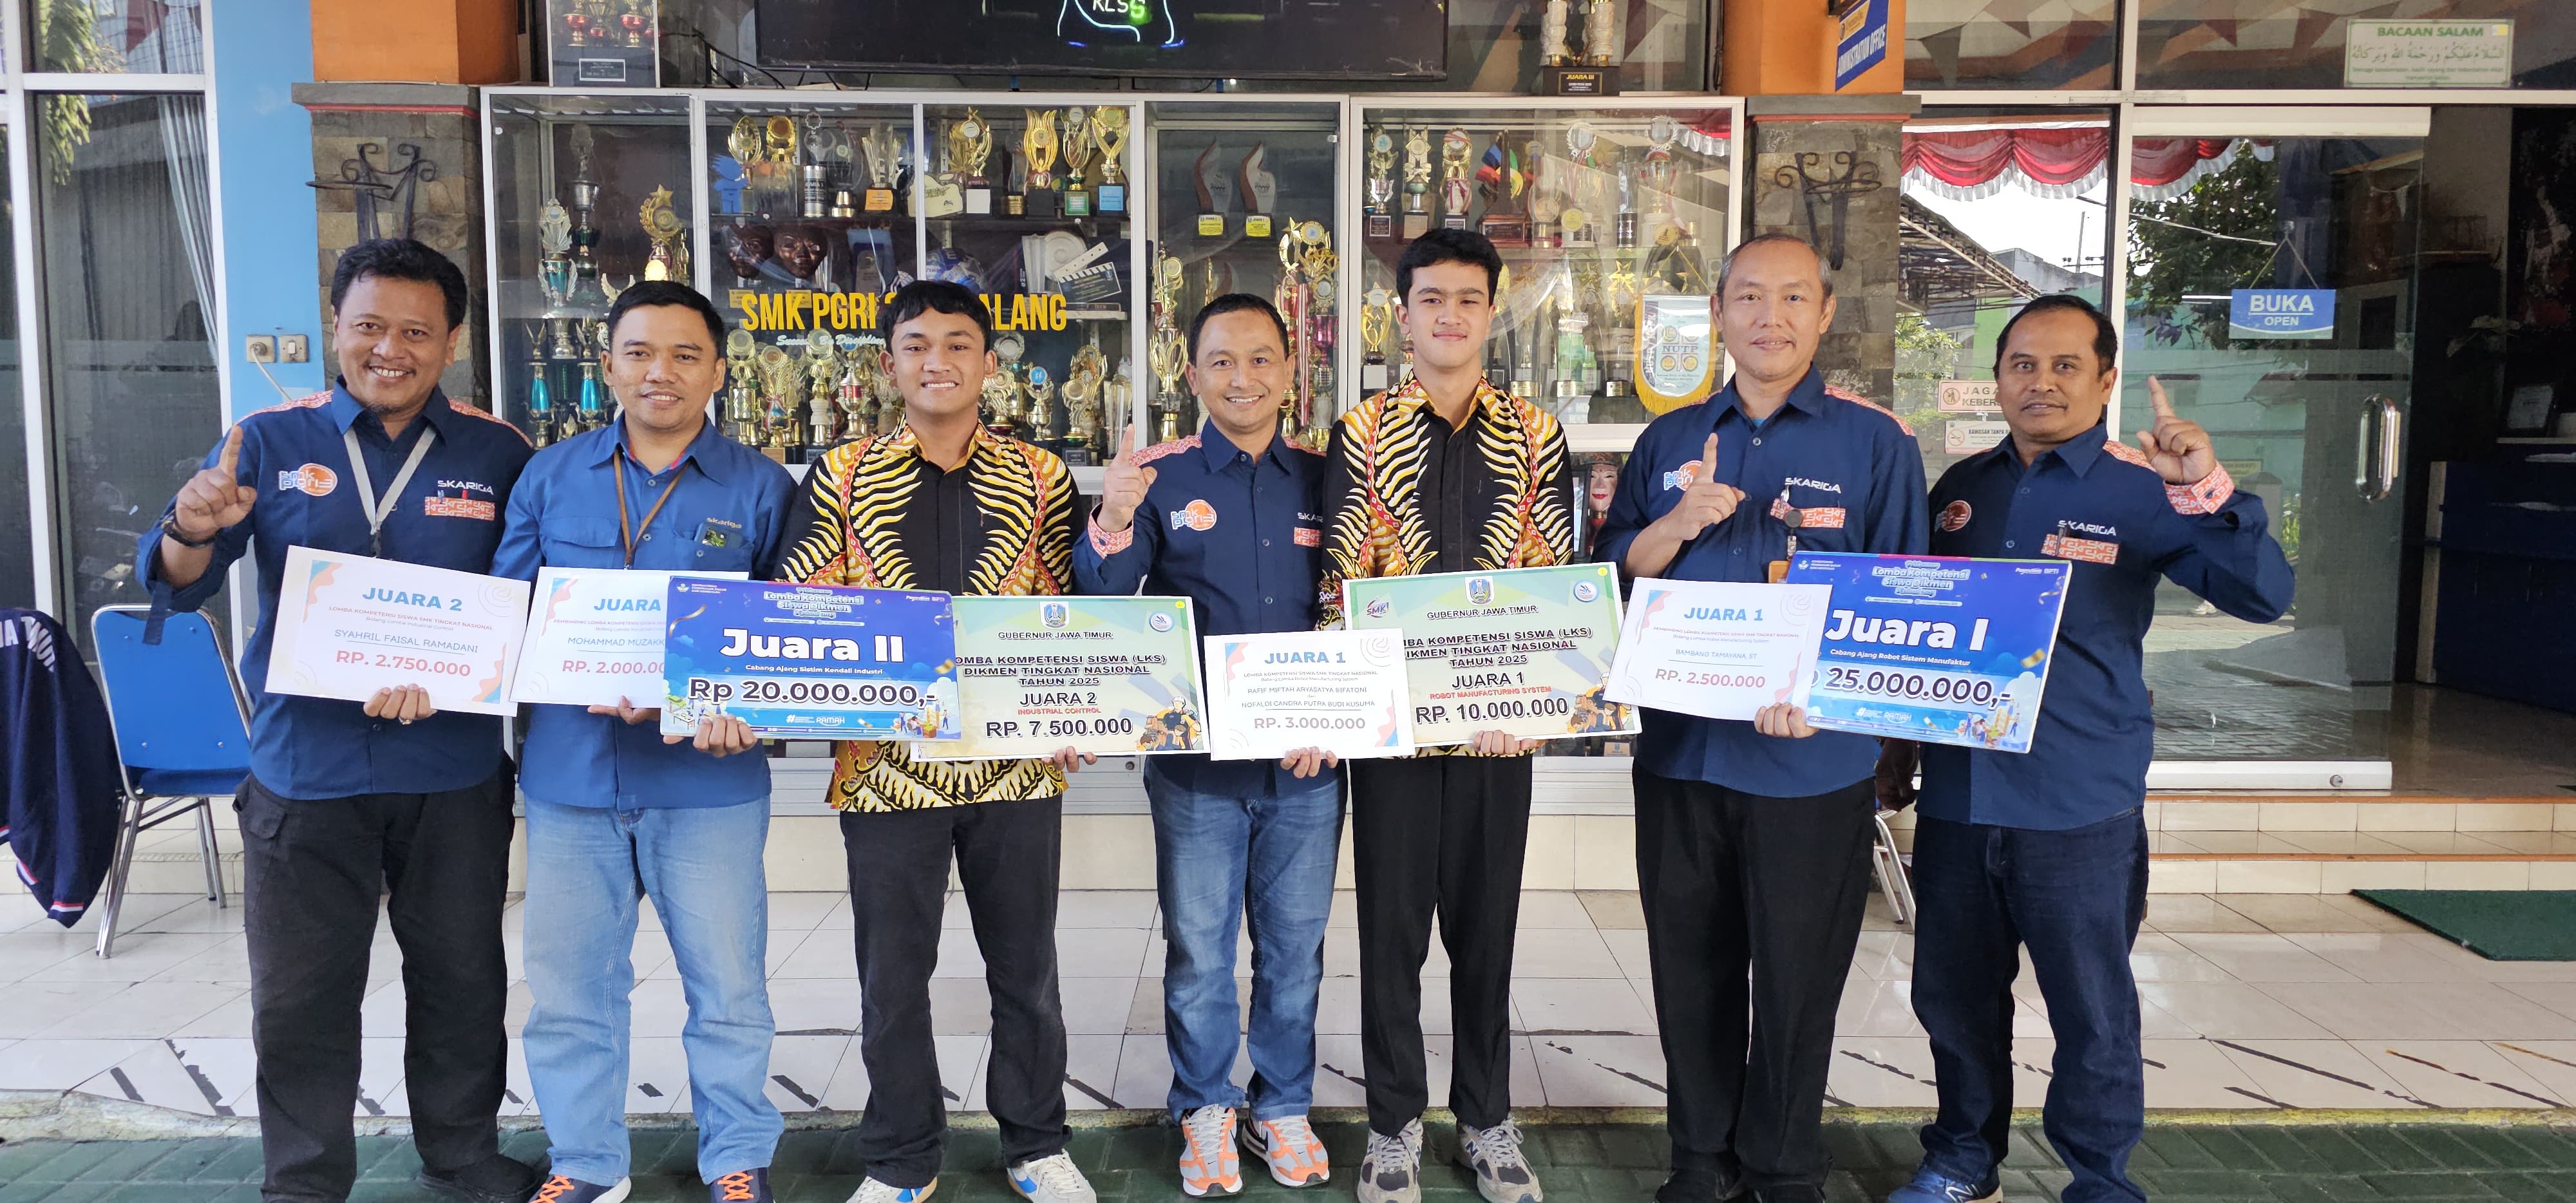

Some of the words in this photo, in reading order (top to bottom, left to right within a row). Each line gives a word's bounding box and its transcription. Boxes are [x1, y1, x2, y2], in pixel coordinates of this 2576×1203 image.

[2377, 27, 2432, 37] BACAAN
[2437, 27, 2484, 37] SALAM
[1870, 24, 1886, 55] OFFICE
[2249, 294, 2314, 312] BUKA
[742, 293, 806, 330] SMK
[813, 292, 876, 330] PGRI
[979, 293, 1066, 330] LANG
[2264, 316, 2299, 326] OPEN
[1963, 386, 2000, 395] JAGA
[437, 479, 495, 495] SKARIGA
[1785, 477, 1842, 494] SKARIGA
[1297, 512, 1324, 523] SKAR
[2058, 520, 2117, 536] SKARIGA
[1872, 566, 1907, 576] Lomba
[1908, 568, 1971, 580] Kompetensi
[1882, 576, 1911, 587] Siswa
[1912, 578, 1953, 590] Dikmen
[362, 587, 442, 609] JUARA
[450, 598, 462, 612] 2
[594, 598, 661, 611] JUARA
[764, 591, 801, 602] Lomba
[802, 592, 864, 605] Kompetensi
[777, 601, 809, 611] Siswa
[810, 602, 851, 612] Dikmen
[1427, 609, 1479, 620] GUBERNUR
[1481, 607, 1506, 616] JAWA
[1508, 605, 1539, 614] TIMUR
[354, 609, 396, 618] KOMPETENSI
[397, 613, 418, 621] SISWA
[434, 618, 461, 627] TINGKAT
[462, 622, 493, 630] NASIONAL
[1683, 607, 1747, 621] JUARA
[1754, 609, 1763, 621] 1
[998, 631, 1053, 639] GUBERNUR
[1055, 631, 1081, 639] JAWA
[1083, 631, 1113, 639] TIMUR
[1428, 633, 1511, 645] KOMPETENSI
[1514, 630, 1555, 640] SISWA
[1558, 627, 1593, 638] (LKS)
[1824, 609, 1956, 649] Juara
[1969, 618, 1989, 651] I
[334, 629, 381, 641] SYAHRIL
[384, 634, 421, 646] FAISAL
[423, 639, 478, 653] RAMADANI
[567, 637, 625, 647] MOHAMMAD
[627, 638, 665, 647] MUZAKK
[719, 628, 860, 662] Juara
[874, 634, 904, 663] II
[1406, 649, 1447, 658] IKMEN
[1451, 645, 1508, 656] TINGKAT
[1511, 639, 1577, 651] NASIONAL
[1676, 649, 1710, 658] BAMBANG
[336, 650, 369, 665] RP.
[375, 654, 471, 677] 2.750.000
[956, 656, 992, 665] OMBA
[998, 656, 1083, 665] KOMPETENSI
[1088, 655, 1128, 664] SISWA
[1132, 654, 1166, 664] (LKS)
[1264, 652, 1329, 664] JUARA
[1336, 652, 1346, 663] 1
[1449, 658, 1493, 668] TAHUN
[1498, 655, 1528, 665] 2025
[1830, 648, 1857, 658] Cabang
[1857, 650, 1879, 661] Ajang
[1879, 652, 1900, 661] Robot
[1902, 654, 1926, 663] Sistem
[1927, 656, 1971, 667] Manufaktur
[562, 660, 591, 673] RP.
[745, 665, 775, 673] Cabang
[775, 665, 799, 674] Ajang
[964, 667, 1018, 676] DIKMEN
[1021, 667, 1080, 675] TINGKAT
[1084, 665, 1151, 674] NASIONAL
[1069, 677, 1101, 686] 2025
[1452, 673, 1511, 689] JUARA
[1517, 672, 1525, 685] 1
[1655, 668, 1681, 682] RP.
[1686, 672, 1766, 688] 2.500.000
[688, 677, 733, 704] Rp
[741, 679, 937, 709] 20.000.000,-
[1457, 688, 1521, 699] MANUFACTURING
[1522, 686, 1552, 694] SYSTEM
[1824, 667, 2012, 710] 25.000.000,-
[1019, 692, 1083, 706] JUARA
[1086, 692, 1097, 705] 2
[1416, 705, 1450, 725] RP.
[1457, 697, 1569, 722] 10.000.000
[816, 716, 845, 725] RAMAH
[986, 721, 1022, 737] RP.
[1029, 718, 1133, 737] 7.500.000
[1254, 717, 1281, 729] RP.
[1285, 717, 1366, 729] 3.000.000
